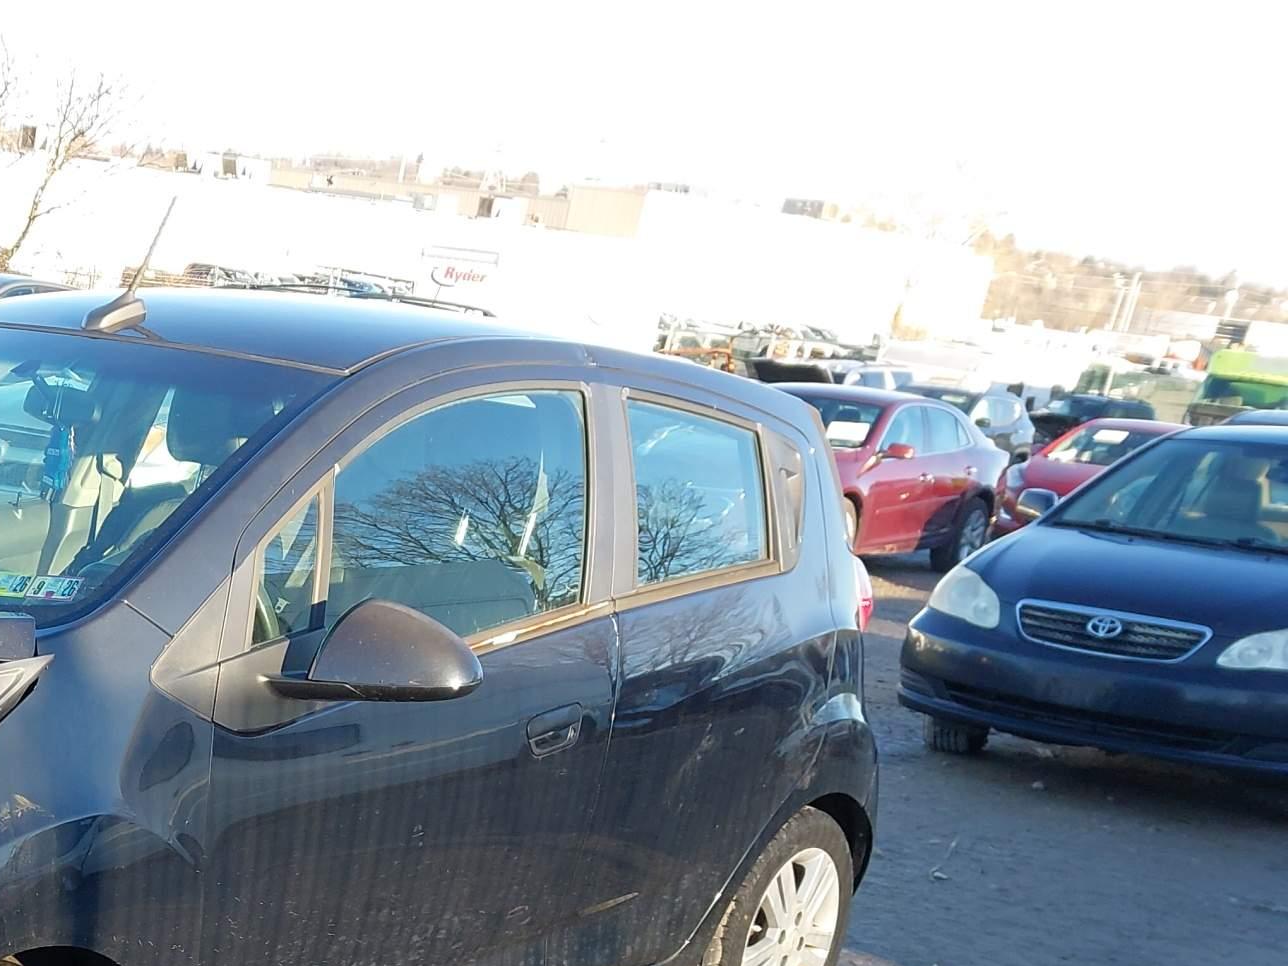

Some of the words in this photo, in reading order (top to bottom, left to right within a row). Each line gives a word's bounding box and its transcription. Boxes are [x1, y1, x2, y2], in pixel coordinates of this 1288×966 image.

[444, 267, 486, 282] Ryder
[15, 576, 31, 592] 26
[62, 580, 78, 596] 26
